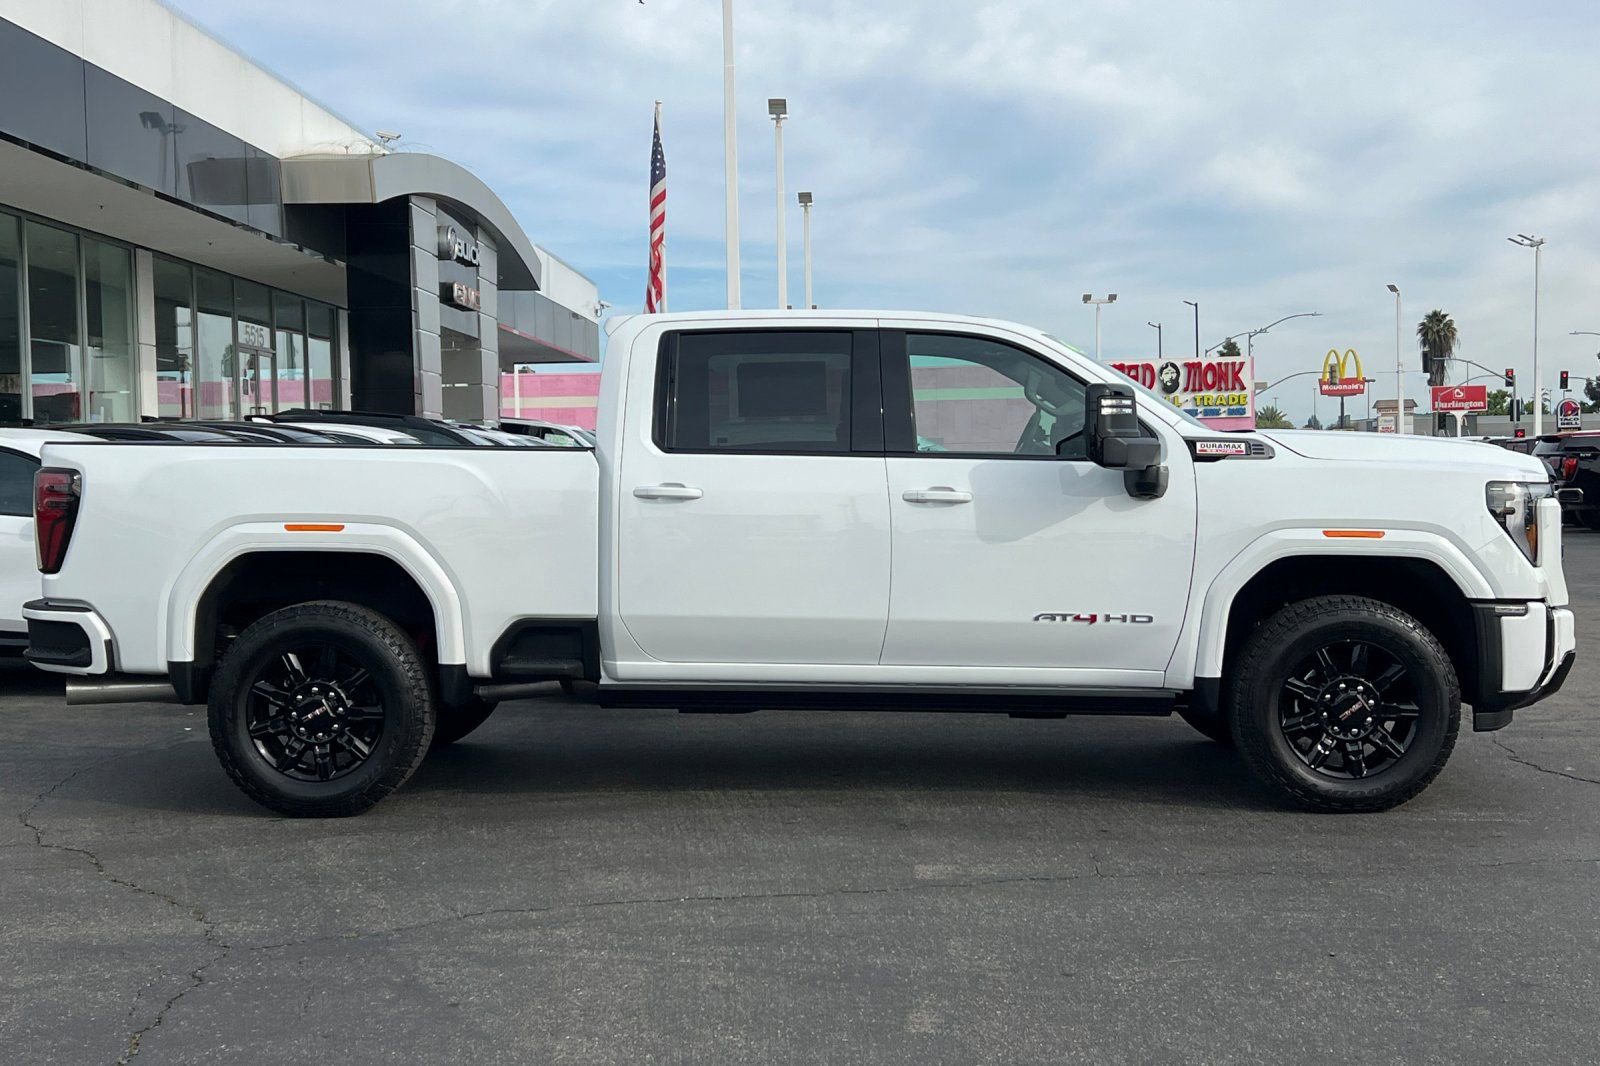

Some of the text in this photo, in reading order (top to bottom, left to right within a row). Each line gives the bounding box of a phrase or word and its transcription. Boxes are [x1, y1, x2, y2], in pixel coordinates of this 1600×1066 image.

[456, 238, 480, 265] BUIC
[245, 324, 265, 347] 5515
[1183, 361, 1247, 392] MONK
[1321, 383, 1364, 391] McDonald's
[1194, 393, 1248, 407] TRADE
[1033, 613, 1154, 626] AT4 HD
